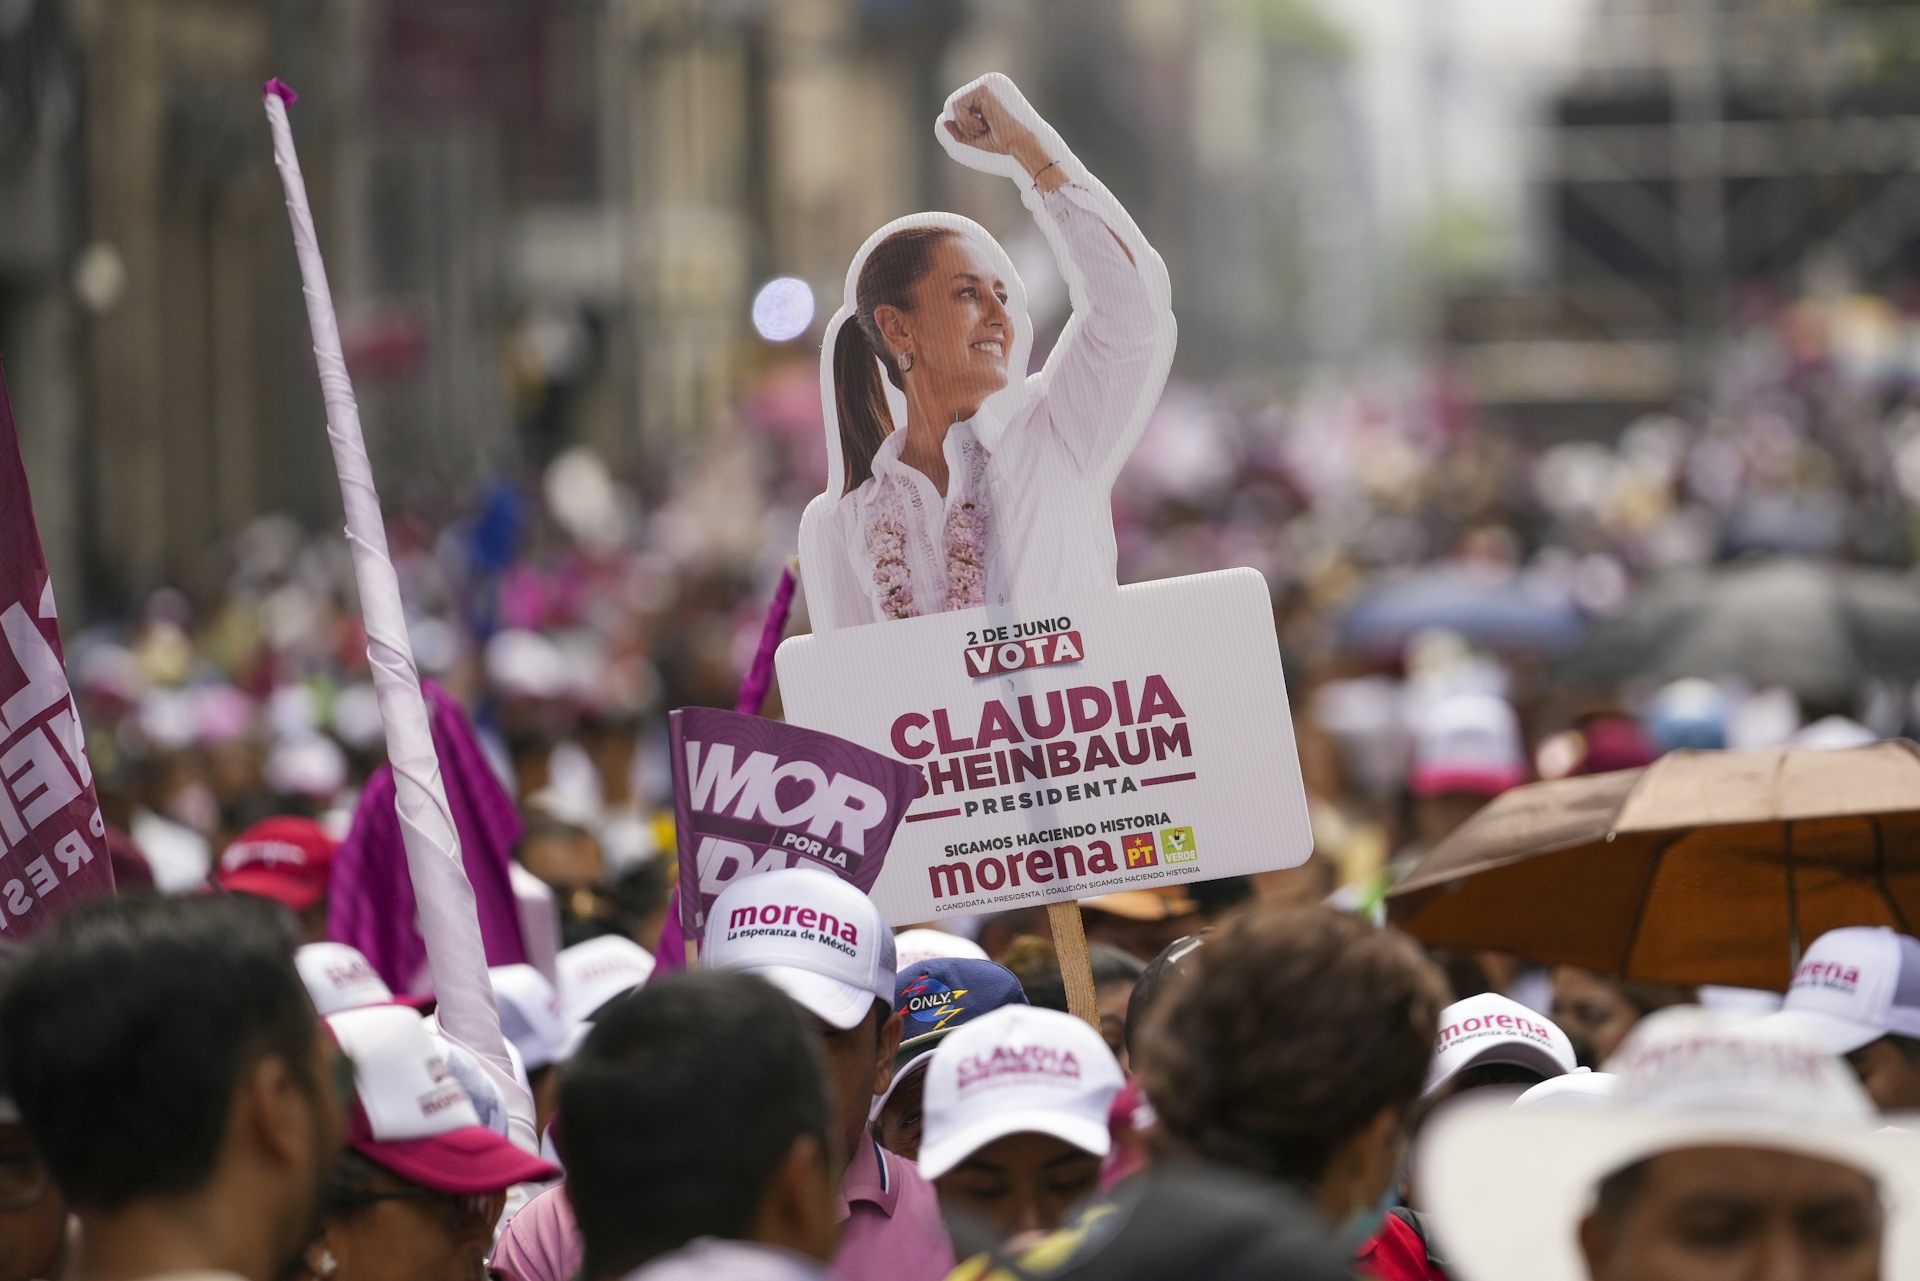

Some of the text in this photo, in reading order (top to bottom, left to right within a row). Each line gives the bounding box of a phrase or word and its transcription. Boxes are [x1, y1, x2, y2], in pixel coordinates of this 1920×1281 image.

[966, 616, 1072, 646] 2 DE JUNIO
[966, 634, 1081, 674] VOTA
[890, 674, 1187, 760] CLAUDIA
[964, 776, 1138, 817] PRESIDENTA
[782, 832, 848, 868] POR LA
[944, 812, 1171, 857] SIGAMOS HACIENDO HISTORIA
[928, 840, 1118, 898] morena
[1127, 846, 1153, 867] PT
[1165, 850, 1197, 863] VERDE
[942, 898, 986, 911] CANDIDATA
[993, 890, 1041, 903] PRESIDENTA
[1046, 883, 1088, 895] COALICIÓN
[1089, 877, 1123, 888] SIGAMOS
[1125, 871, 1165, 883] HACIENDO
[1166, 866, 1201, 877] HISTORIA
[727, 928, 857, 958] La esperanza de México
[729, 904, 858, 946] morena
[1437, 1013, 1551, 1046] morena
